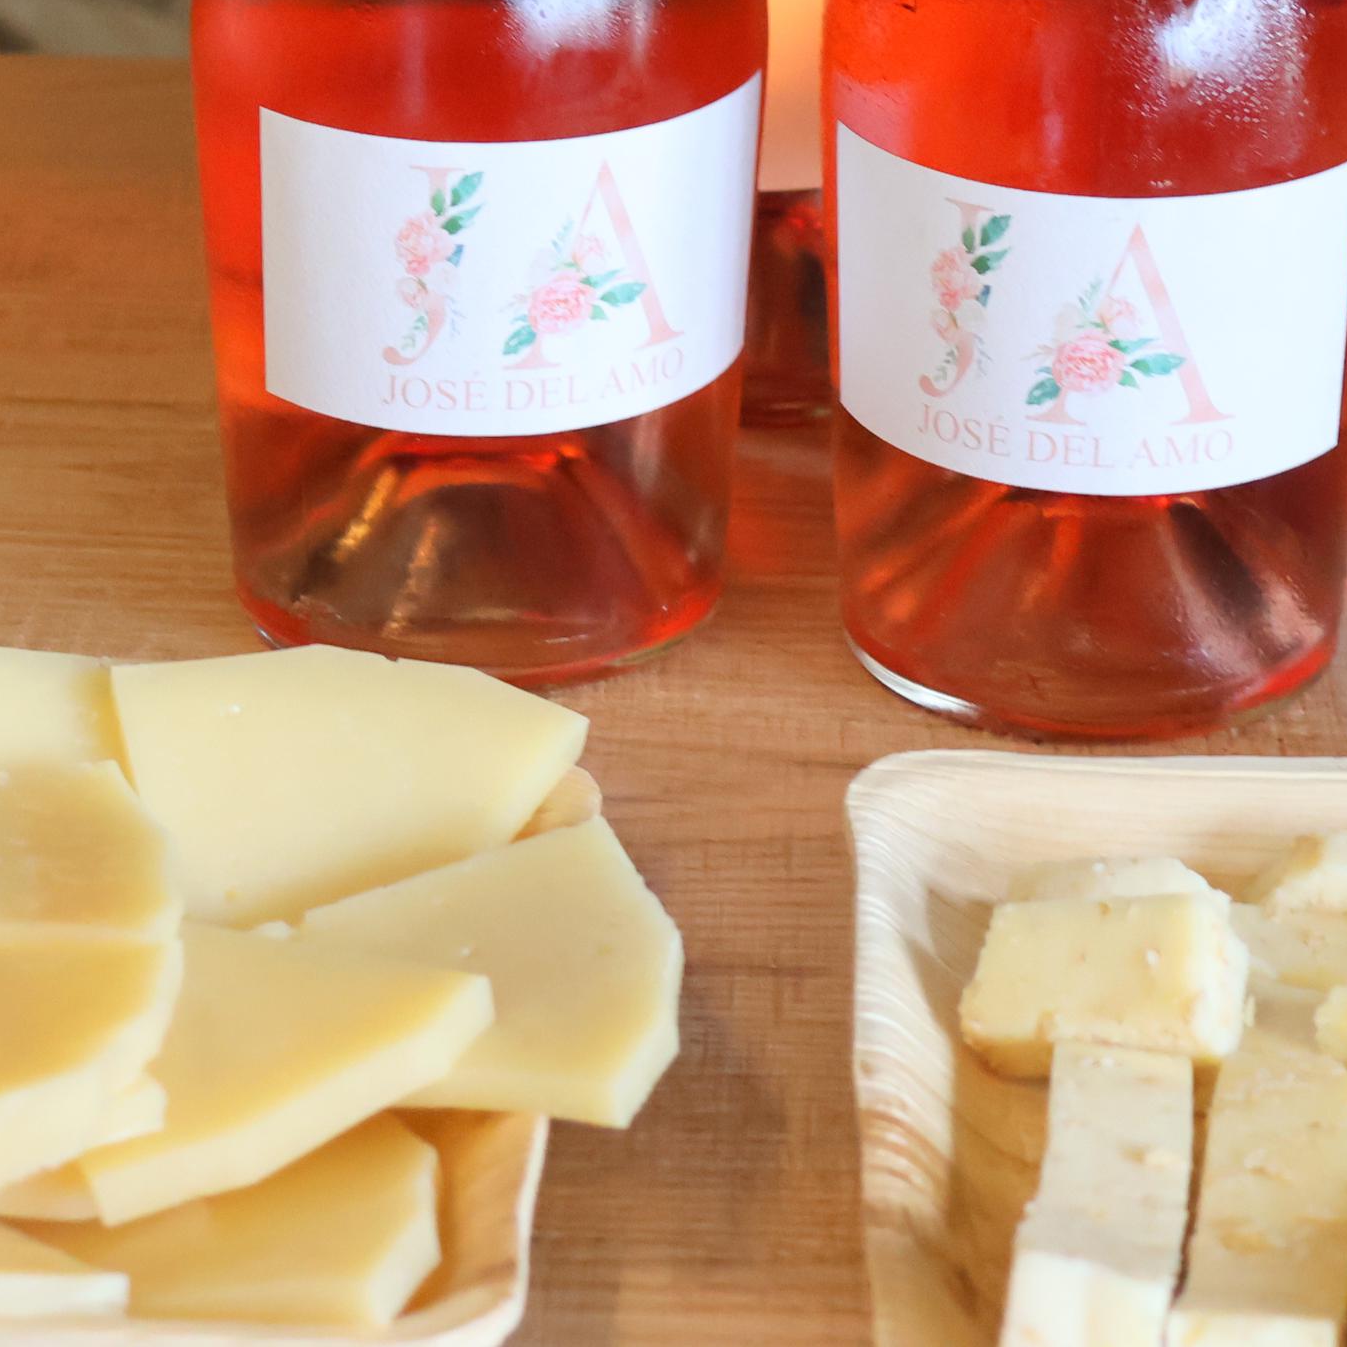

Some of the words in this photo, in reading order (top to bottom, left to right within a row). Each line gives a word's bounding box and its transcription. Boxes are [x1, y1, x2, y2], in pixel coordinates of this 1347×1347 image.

[502, 159, 684, 371] A
[1023, 223, 1236, 426] A
[382, 370, 487, 411] JOSÉ
[505, 374, 588, 411] DEL
[600, 347, 685, 397] AMO
[917, 403, 1012, 457] JOSÉ
[1025, 429, 1115, 469] DEL
[1128, 428, 1235, 469] AMO
